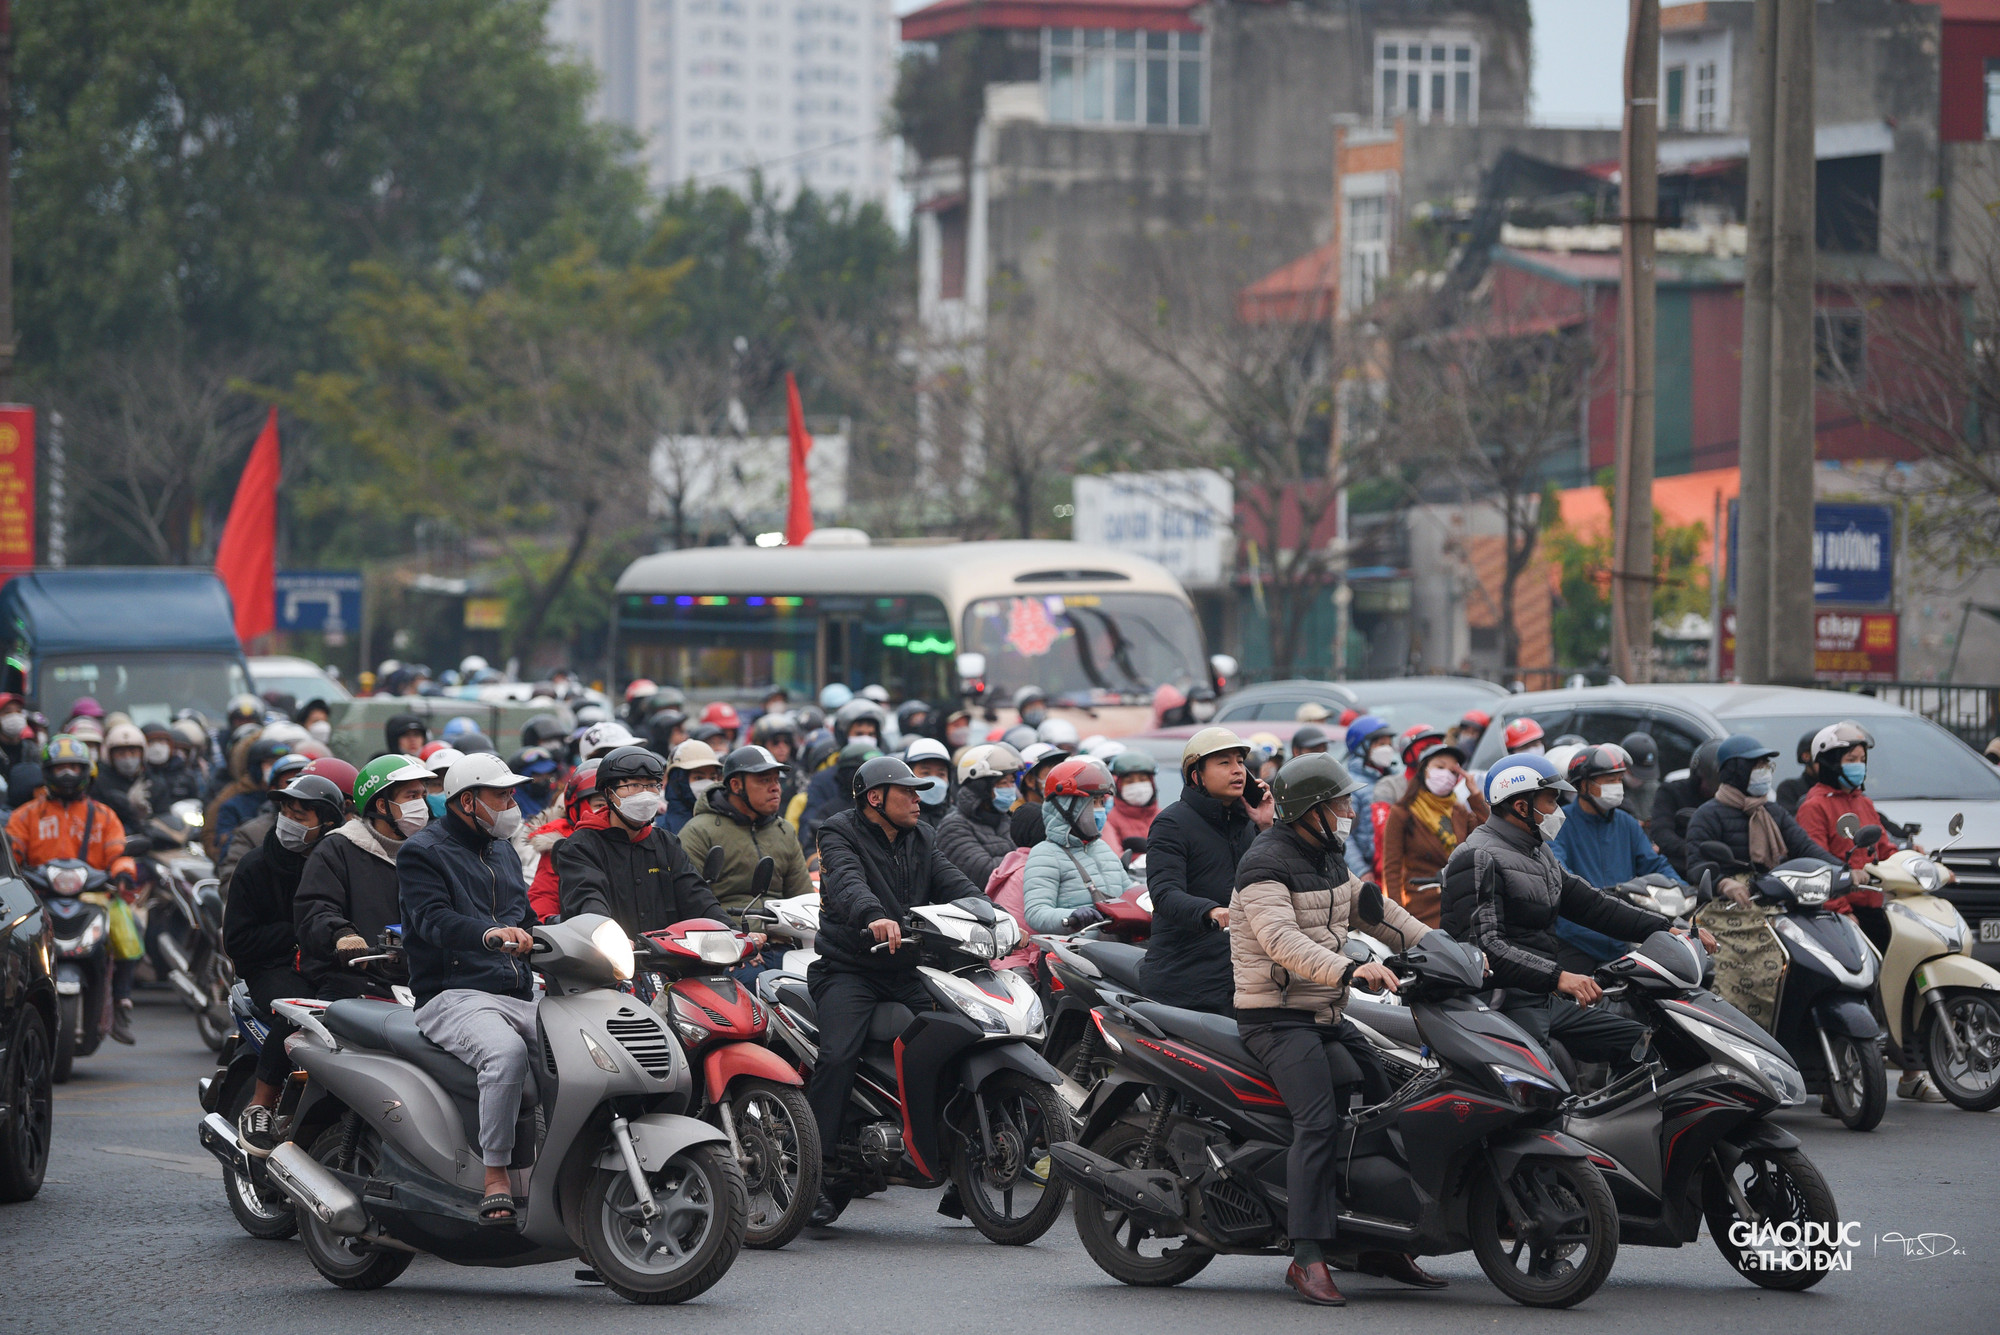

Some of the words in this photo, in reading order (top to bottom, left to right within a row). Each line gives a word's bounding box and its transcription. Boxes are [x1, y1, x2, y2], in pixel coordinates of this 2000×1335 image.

[358, 774, 380, 797] Grab
[1510, 774, 1526, 785] MB
[1732, 1090, 1759, 1103] HONDA
